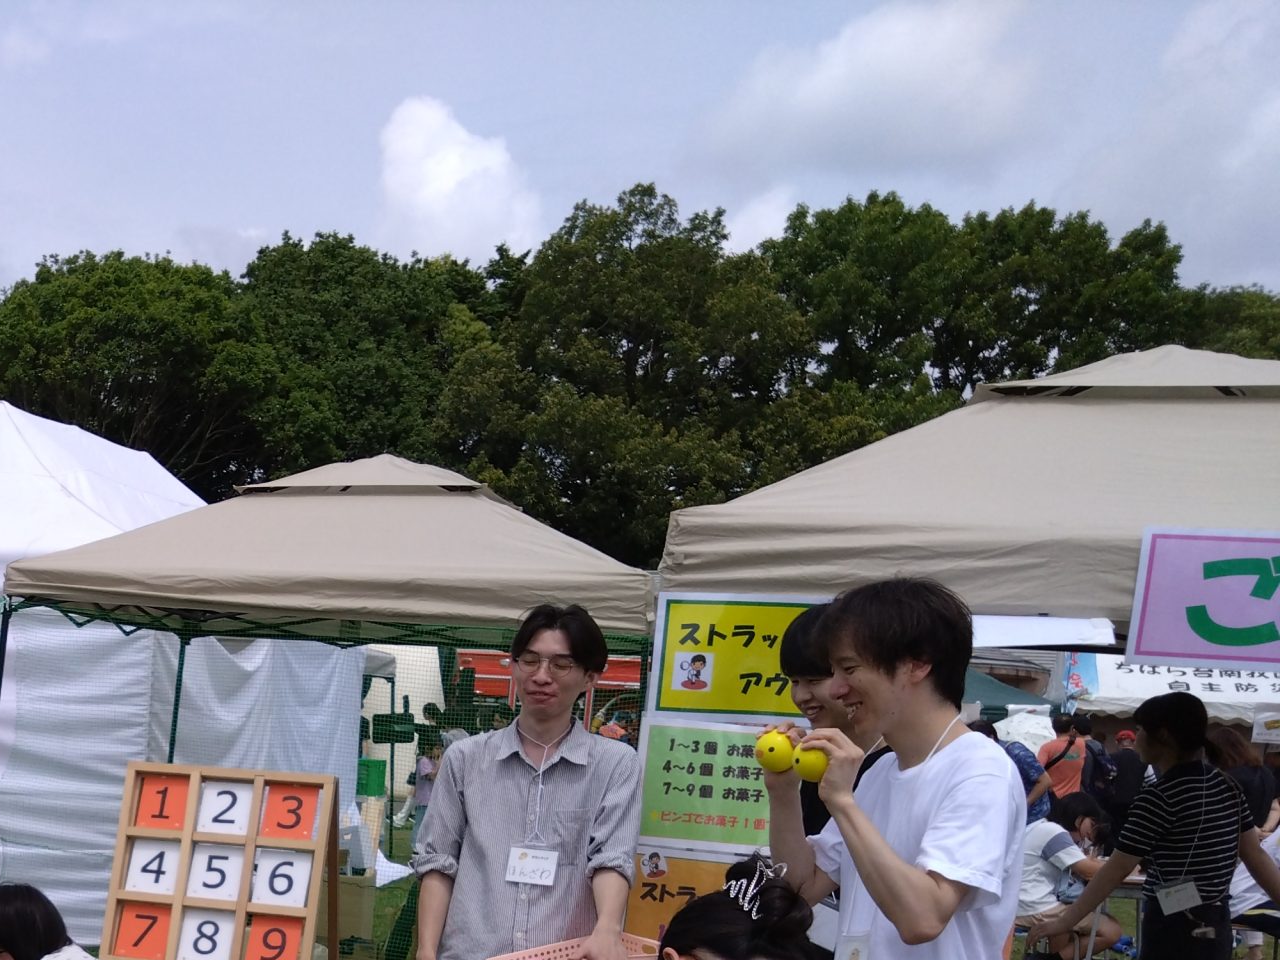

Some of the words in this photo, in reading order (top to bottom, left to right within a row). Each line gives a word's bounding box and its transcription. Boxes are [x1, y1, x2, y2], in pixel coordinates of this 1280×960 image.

[679, 623, 778, 649] ストラッ
[740, 672, 789, 696] アウ
[151, 786, 170, 820] 1
[211, 790, 238, 824] 2
[276, 795, 304, 830] 3
[140, 851, 166, 884] 4
[202, 855, 229, 889] 5
[268, 861, 294, 896] 6
[132, 914, 159, 948] 7
[192, 920, 220, 955] 8
